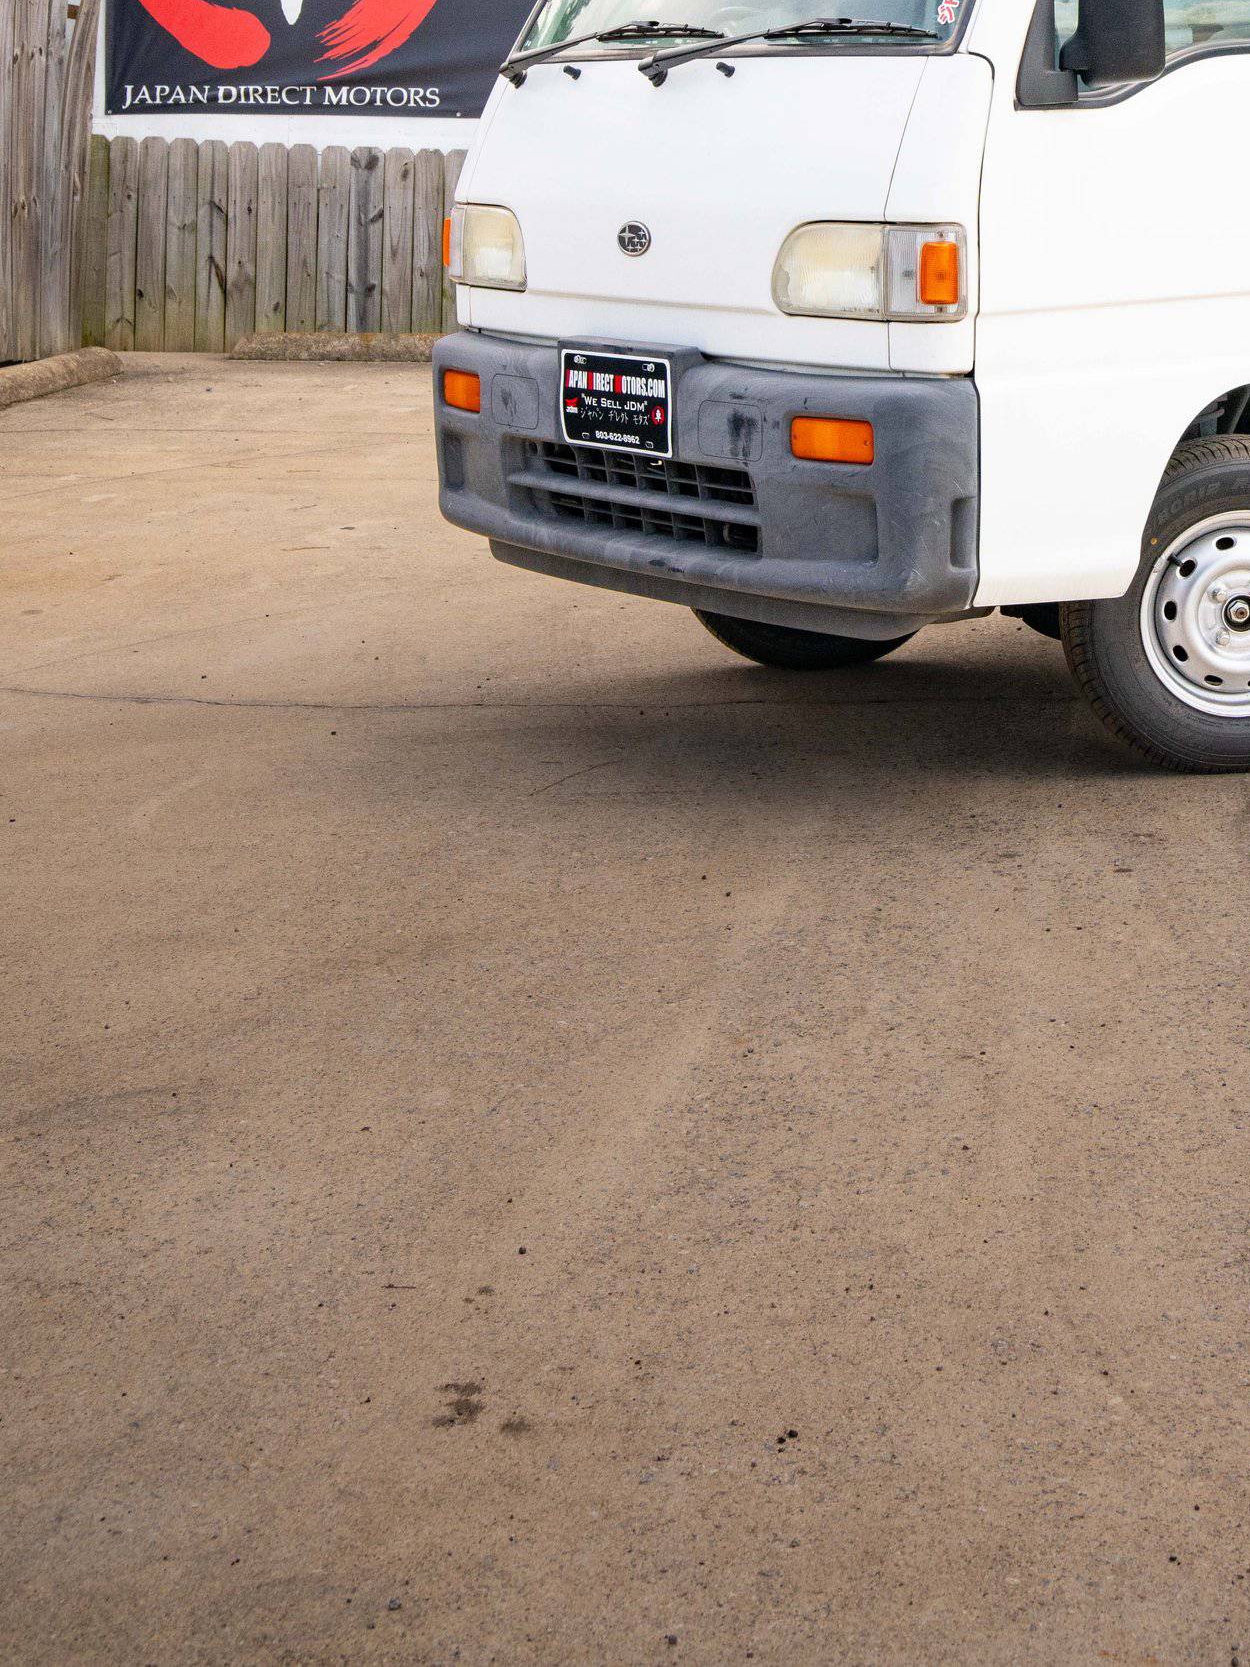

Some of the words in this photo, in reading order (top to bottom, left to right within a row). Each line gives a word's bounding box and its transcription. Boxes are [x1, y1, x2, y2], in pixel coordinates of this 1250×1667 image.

[122, 84, 210, 109] JAPAN
[217, 85, 317, 106] DIRECT
[322, 86, 441, 108] MOTORS
